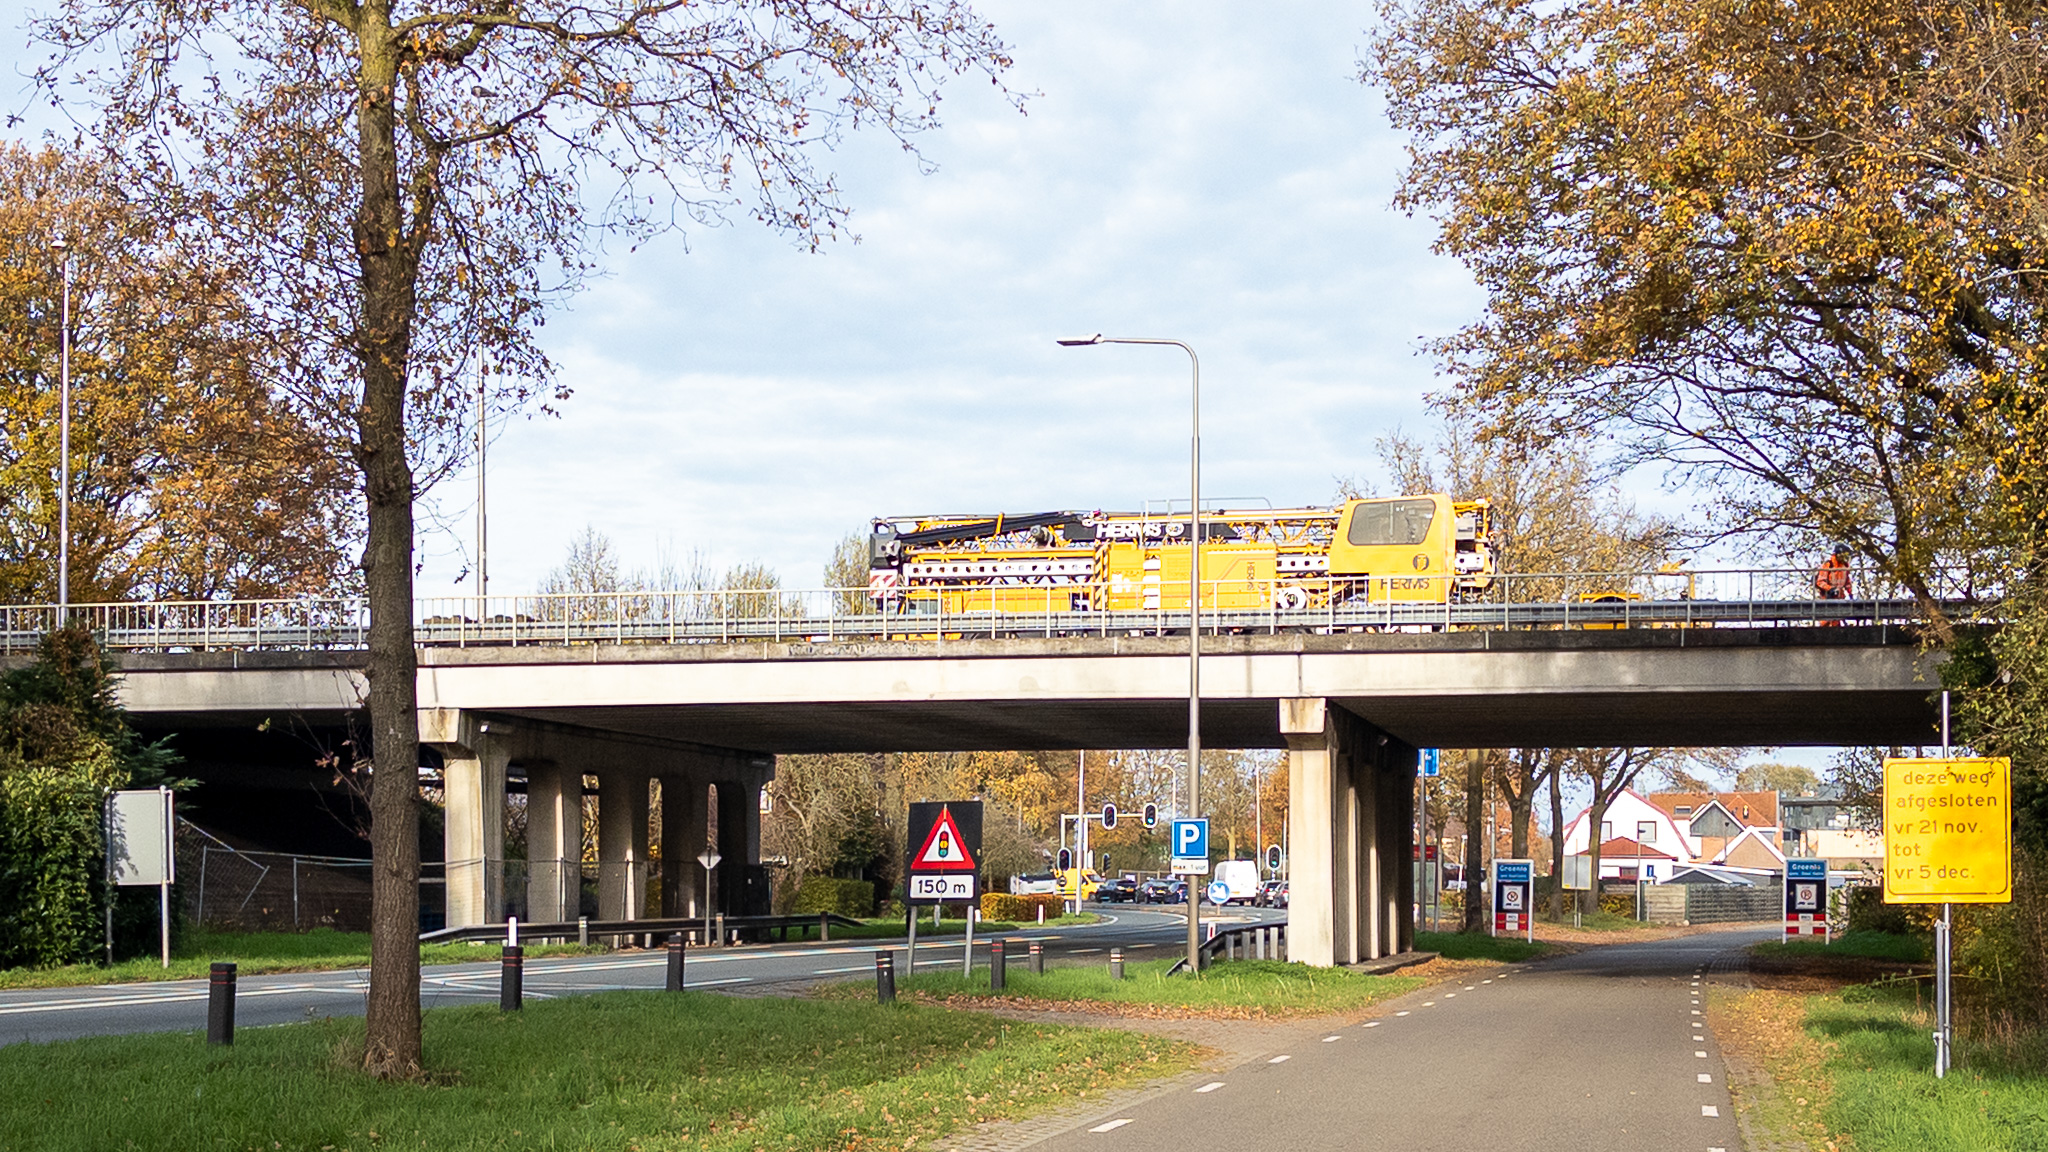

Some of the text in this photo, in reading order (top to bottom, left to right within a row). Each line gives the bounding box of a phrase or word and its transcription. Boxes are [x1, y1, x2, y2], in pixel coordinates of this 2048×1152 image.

[1095, 522, 1162, 539] HERMS
[1380, 577, 1430, 590] HERMS
[1903, 771, 1990, 787] deze weg
[1896, 794, 1997, 811] afgesloten
[1894, 820, 1983, 834] vr 21 nov.
[1180, 824, 1200, 854] P
[1893, 843, 1921, 857] tot
[1895, 865, 1976, 879] vr 5 dec.
[918, 879, 966, 894] 150 m
